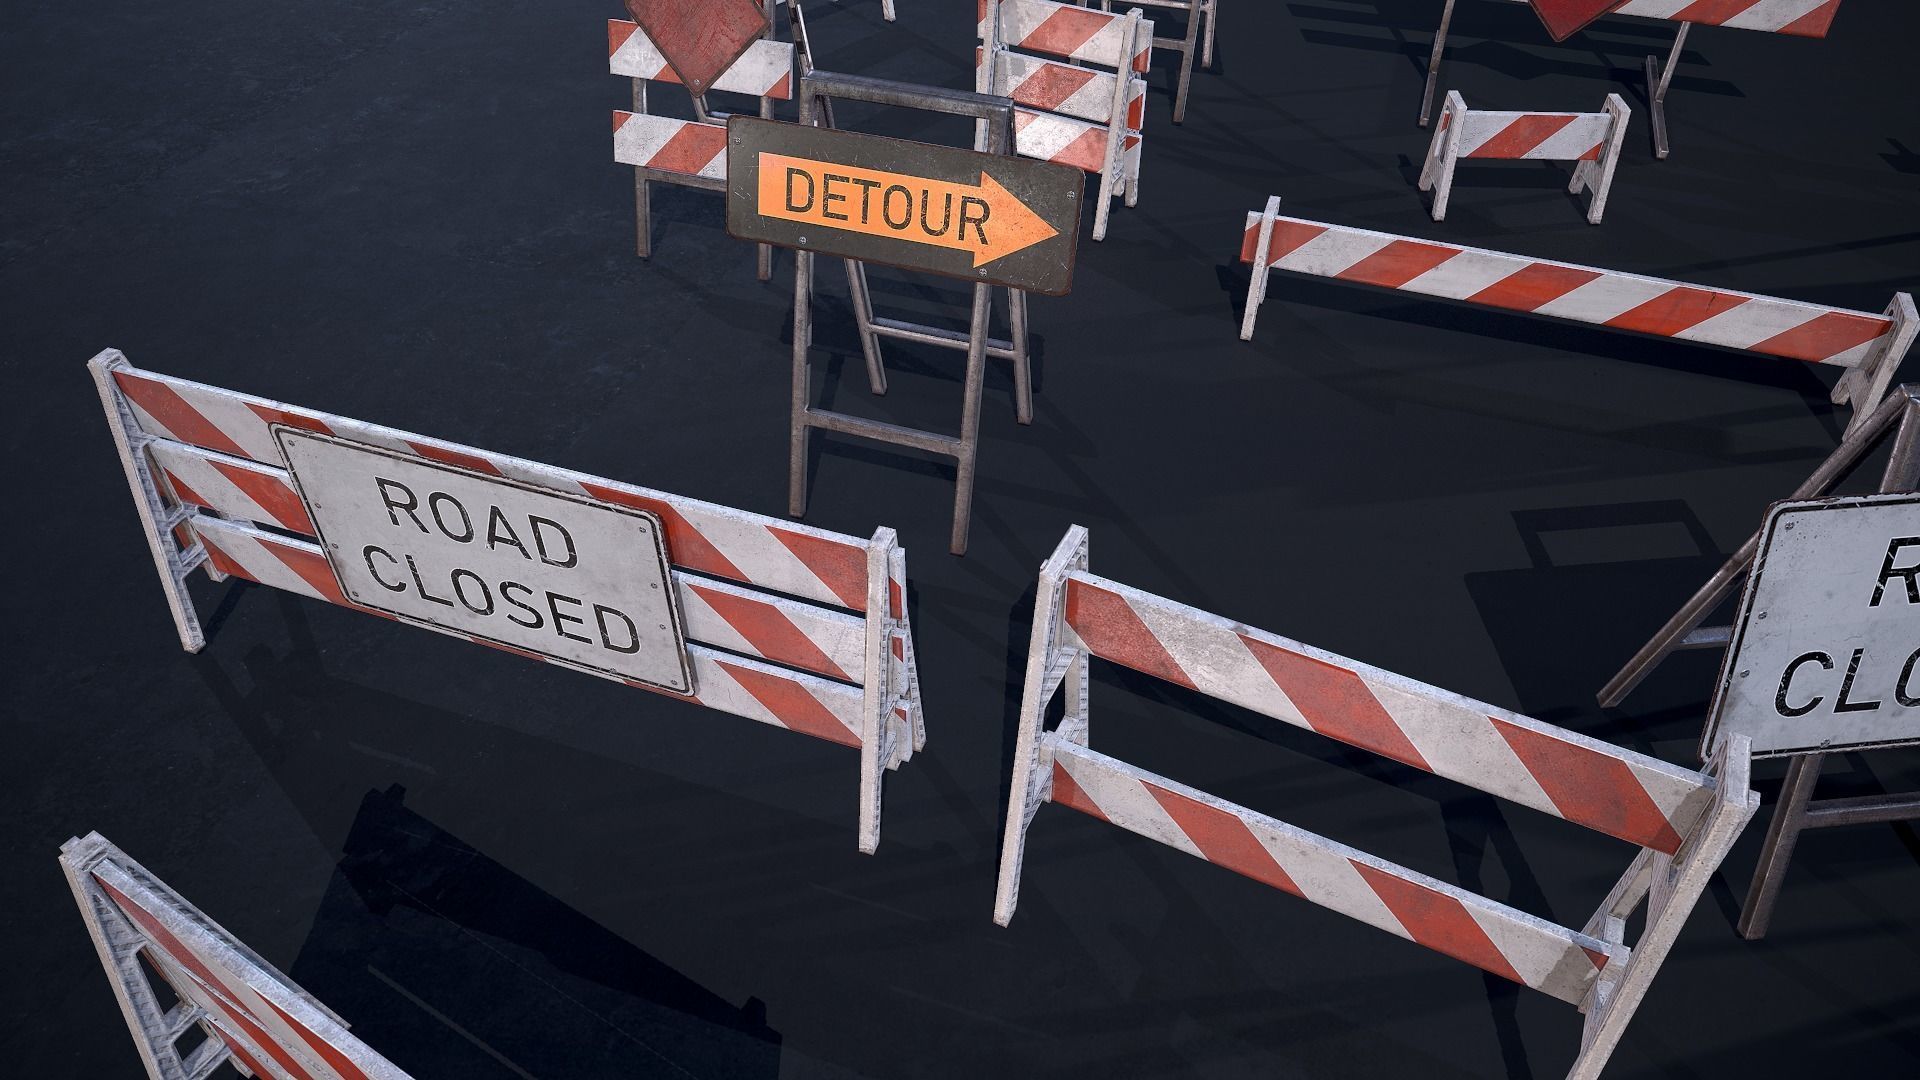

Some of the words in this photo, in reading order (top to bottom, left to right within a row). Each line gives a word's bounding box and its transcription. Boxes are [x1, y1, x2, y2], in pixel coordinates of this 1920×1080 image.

[785, 167, 991, 246] DETOUR
[375, 476, 579, 569] ROAD
[362, 544, 641, 655] CLOSED
